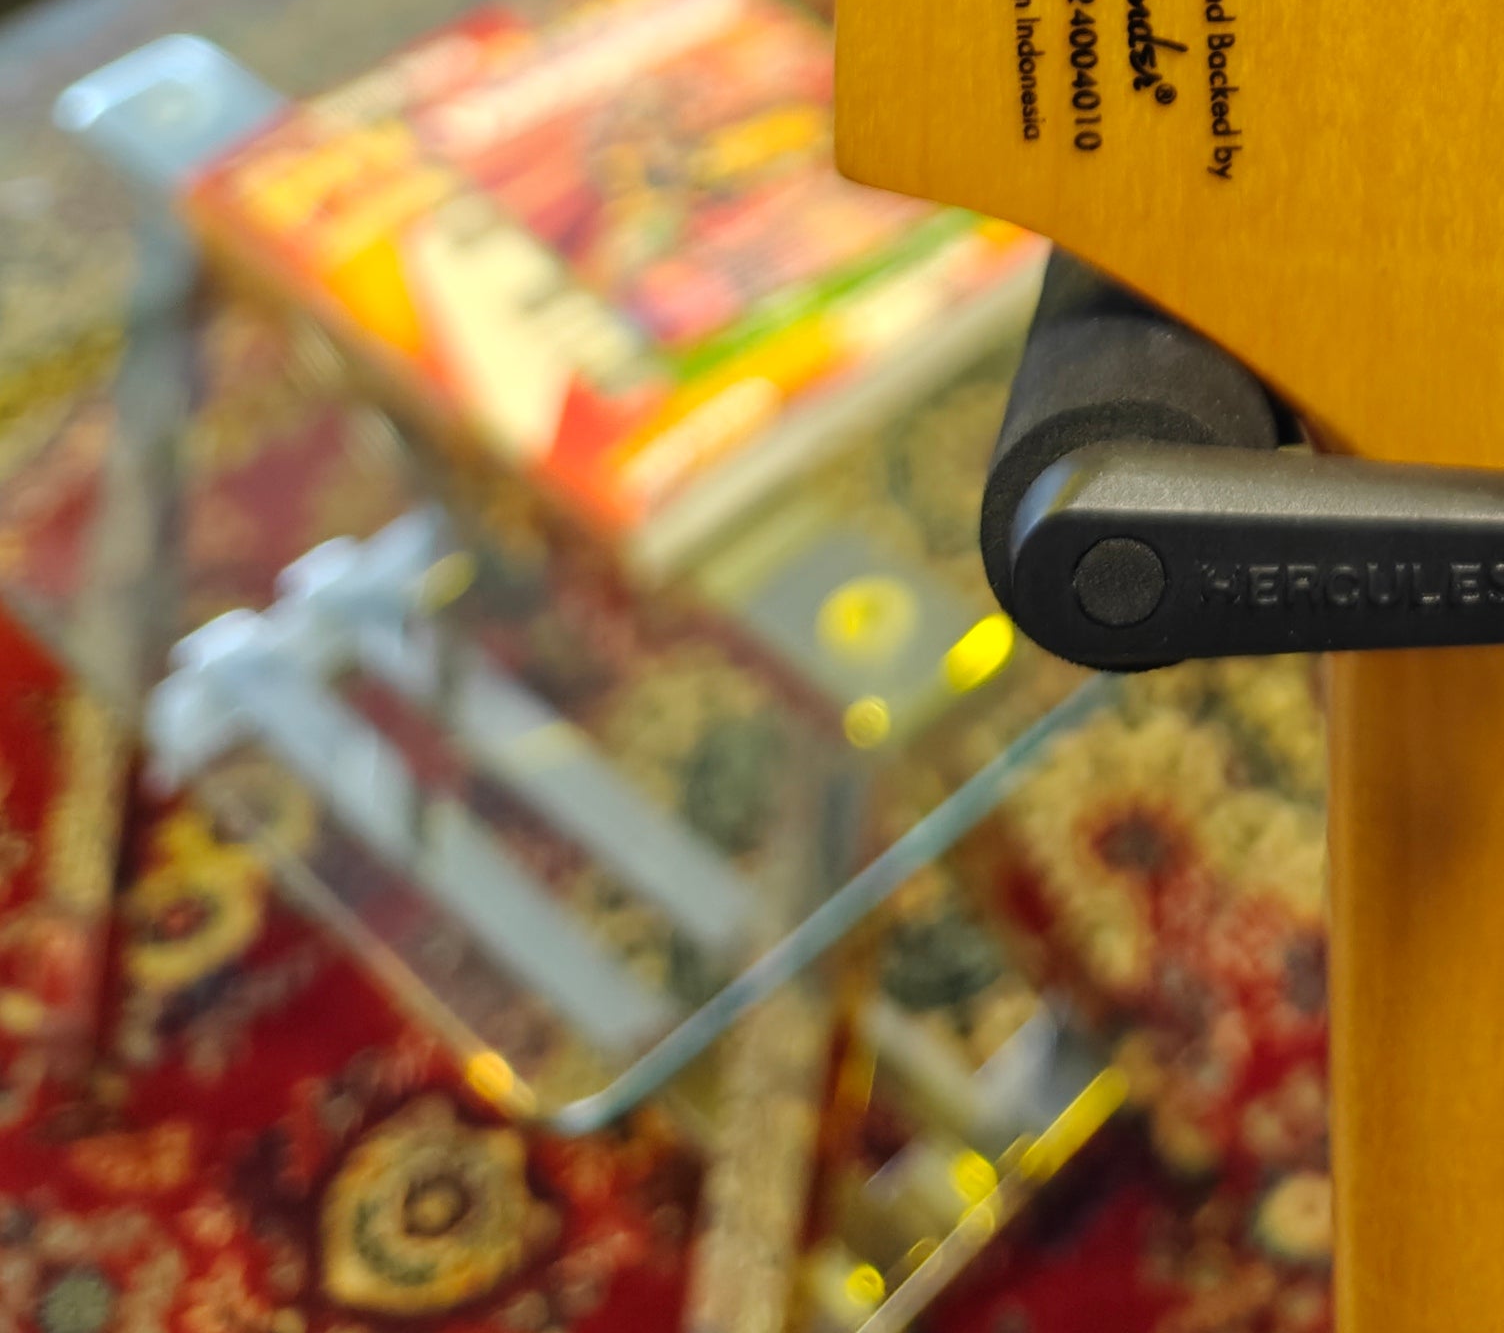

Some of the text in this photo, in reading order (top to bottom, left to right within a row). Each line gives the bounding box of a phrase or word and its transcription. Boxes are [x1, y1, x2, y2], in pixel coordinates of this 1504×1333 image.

[1016, 18, 1047, 140] Indonesia
[1207, 33, 1242, 137] Backed
[1207, 146, 1243, 180] by
